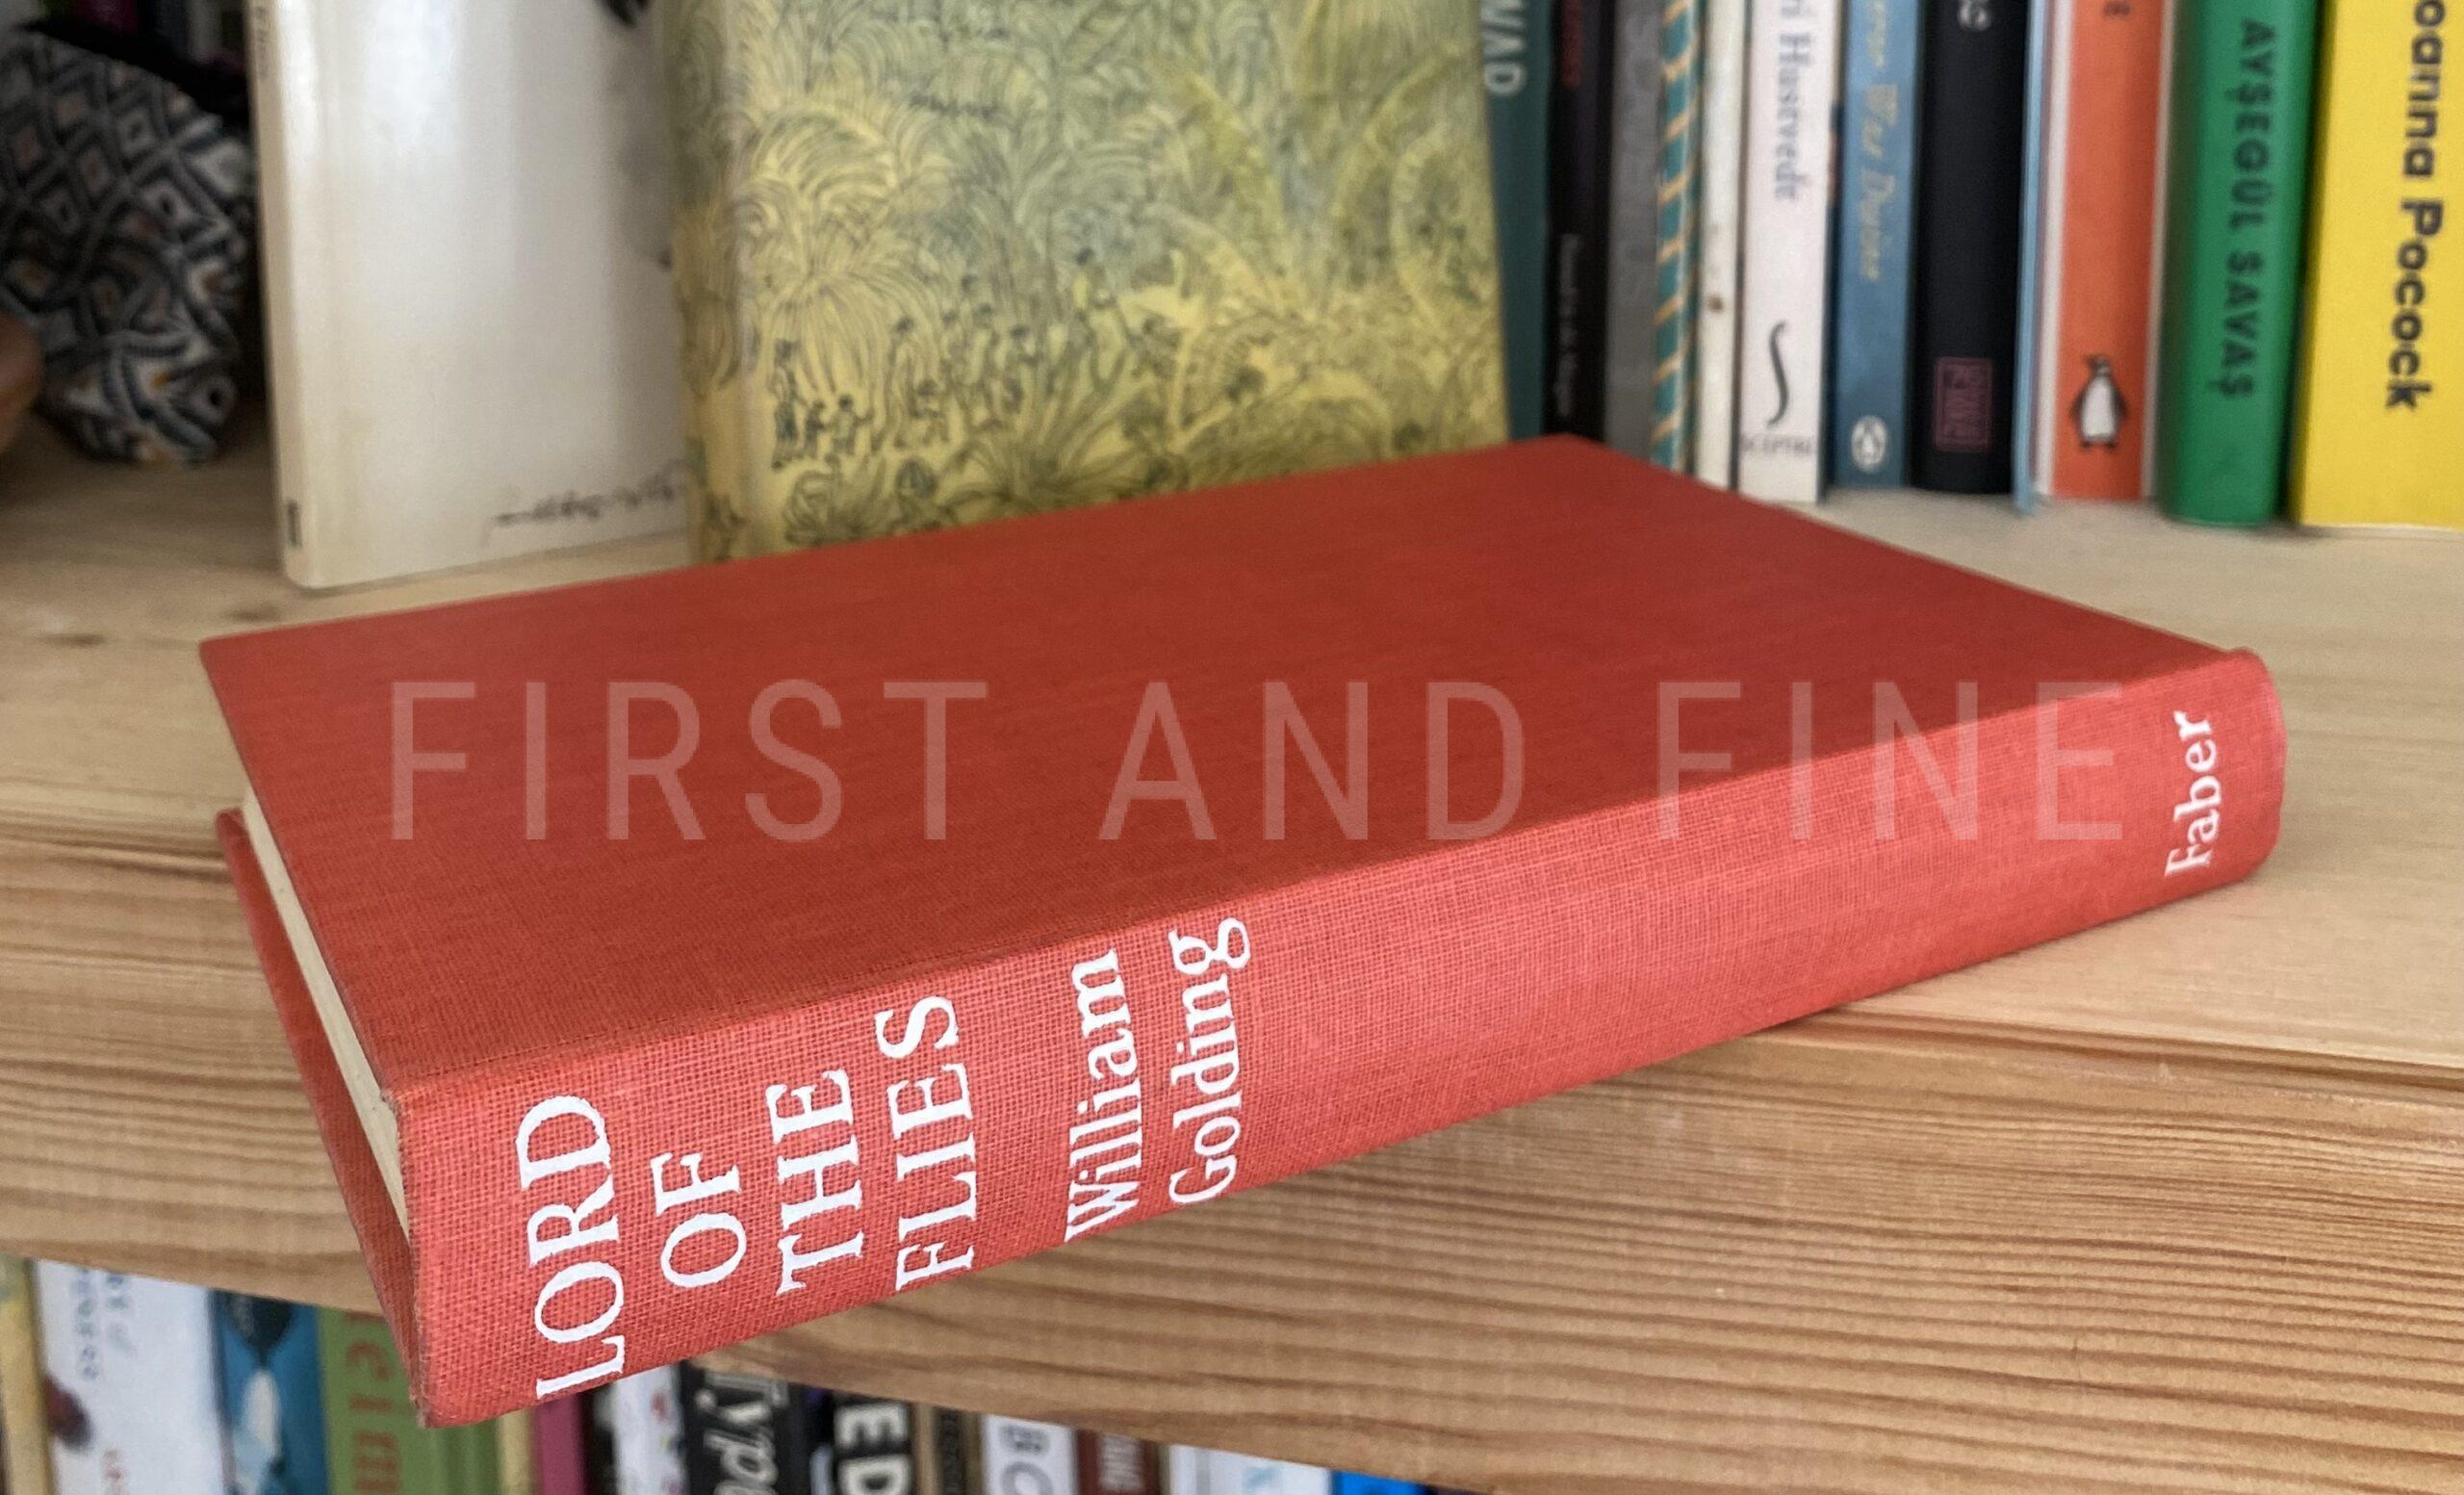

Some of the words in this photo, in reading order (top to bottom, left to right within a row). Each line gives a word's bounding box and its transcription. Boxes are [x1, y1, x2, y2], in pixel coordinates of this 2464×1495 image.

[1775, 31, 1813, 201] Hustvedt
[2402, 0, 2446, 177] oanna
[2211, 251, 2264, 399] SAVAŞ
[2386, 196, 2444, 410] Pocock
[2165, 710, 2222, 877] Faber
[875, 995, 977, 1291] FLIES
[1065, 947, 1143, 1243] William
[1168, 917, 1251, 1206] Golding
[515, 1095, 626, 1399] LORD
[651, 1152, 747, 1288] OF
[765, 1069, 864, 1296] THE
